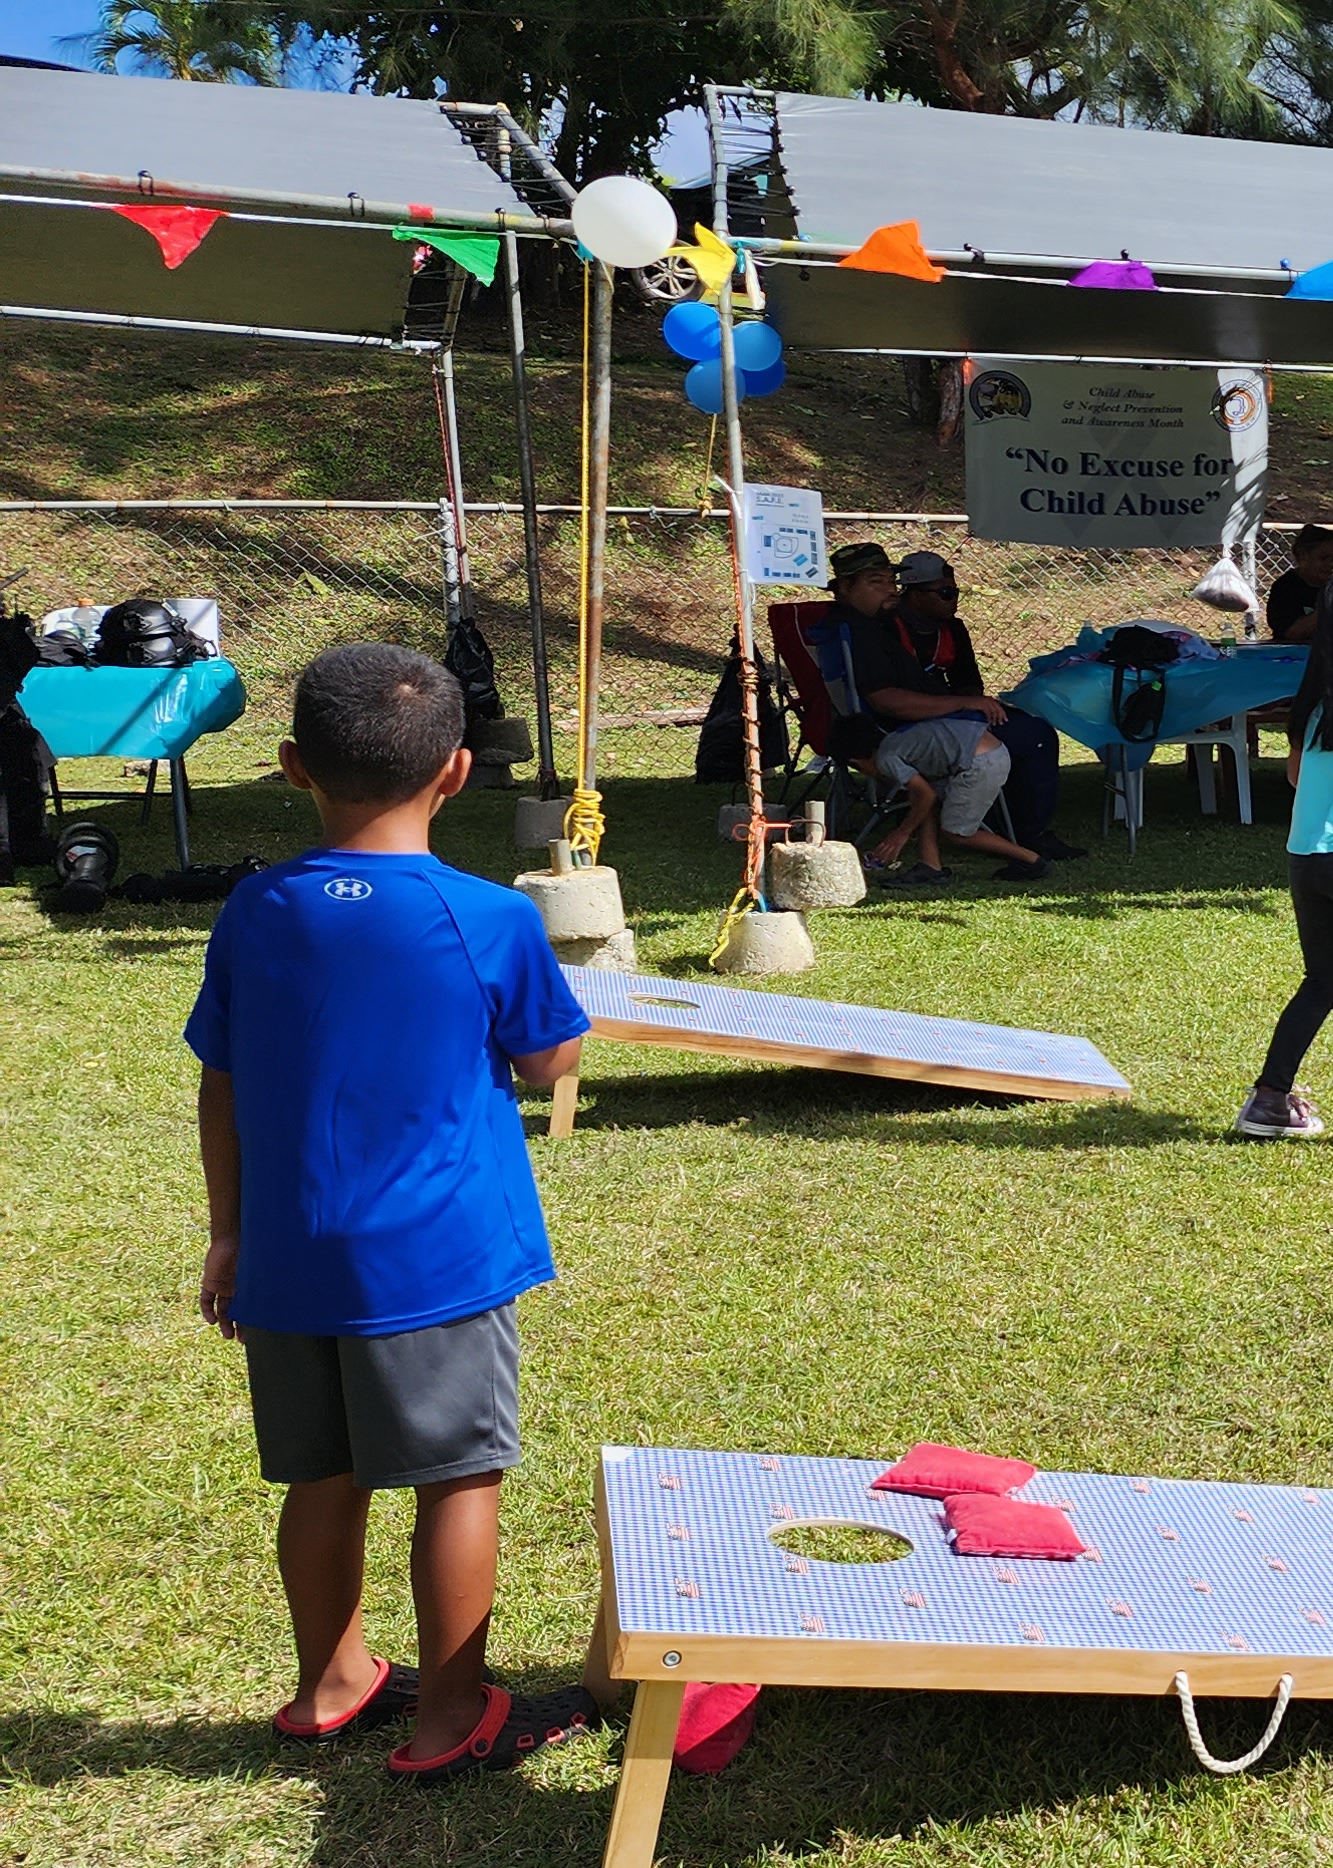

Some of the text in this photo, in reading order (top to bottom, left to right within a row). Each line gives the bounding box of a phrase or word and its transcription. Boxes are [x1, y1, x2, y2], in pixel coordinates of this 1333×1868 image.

[1089, 386, 1156, 400] Child Abuse
[1077, 400, 1122, 414] Neglect
[1124, 403, 1183, 414] Prevention
[1061, 415, 1184, 429] and Awareness Month
[1006, 447, 1234, 477] “No Excuse for
[1020, 488, 1221, 516] Child Abuse”
